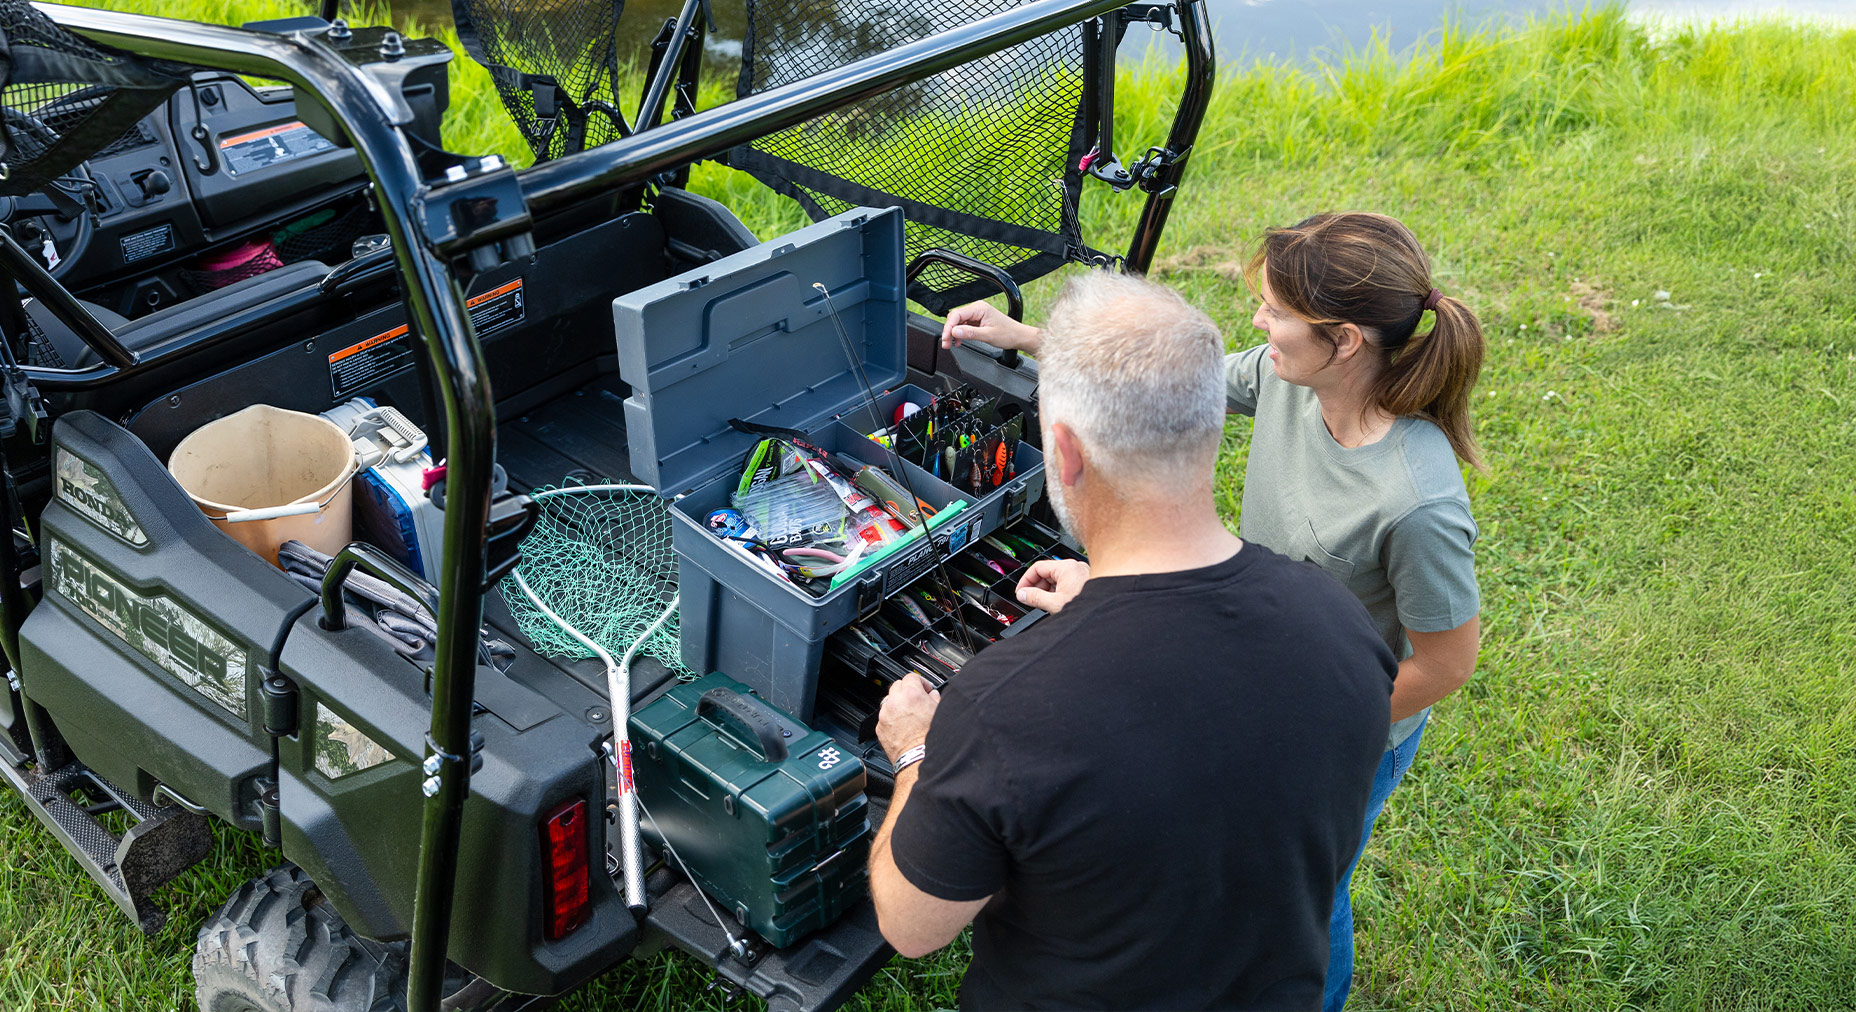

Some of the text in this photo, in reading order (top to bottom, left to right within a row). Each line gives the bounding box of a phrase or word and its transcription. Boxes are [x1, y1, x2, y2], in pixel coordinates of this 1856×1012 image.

[365, 333, 391, 347] WARNING
[61, 477, 133, 536] HONDA
[62, 551, 229, 690] PIONEER
